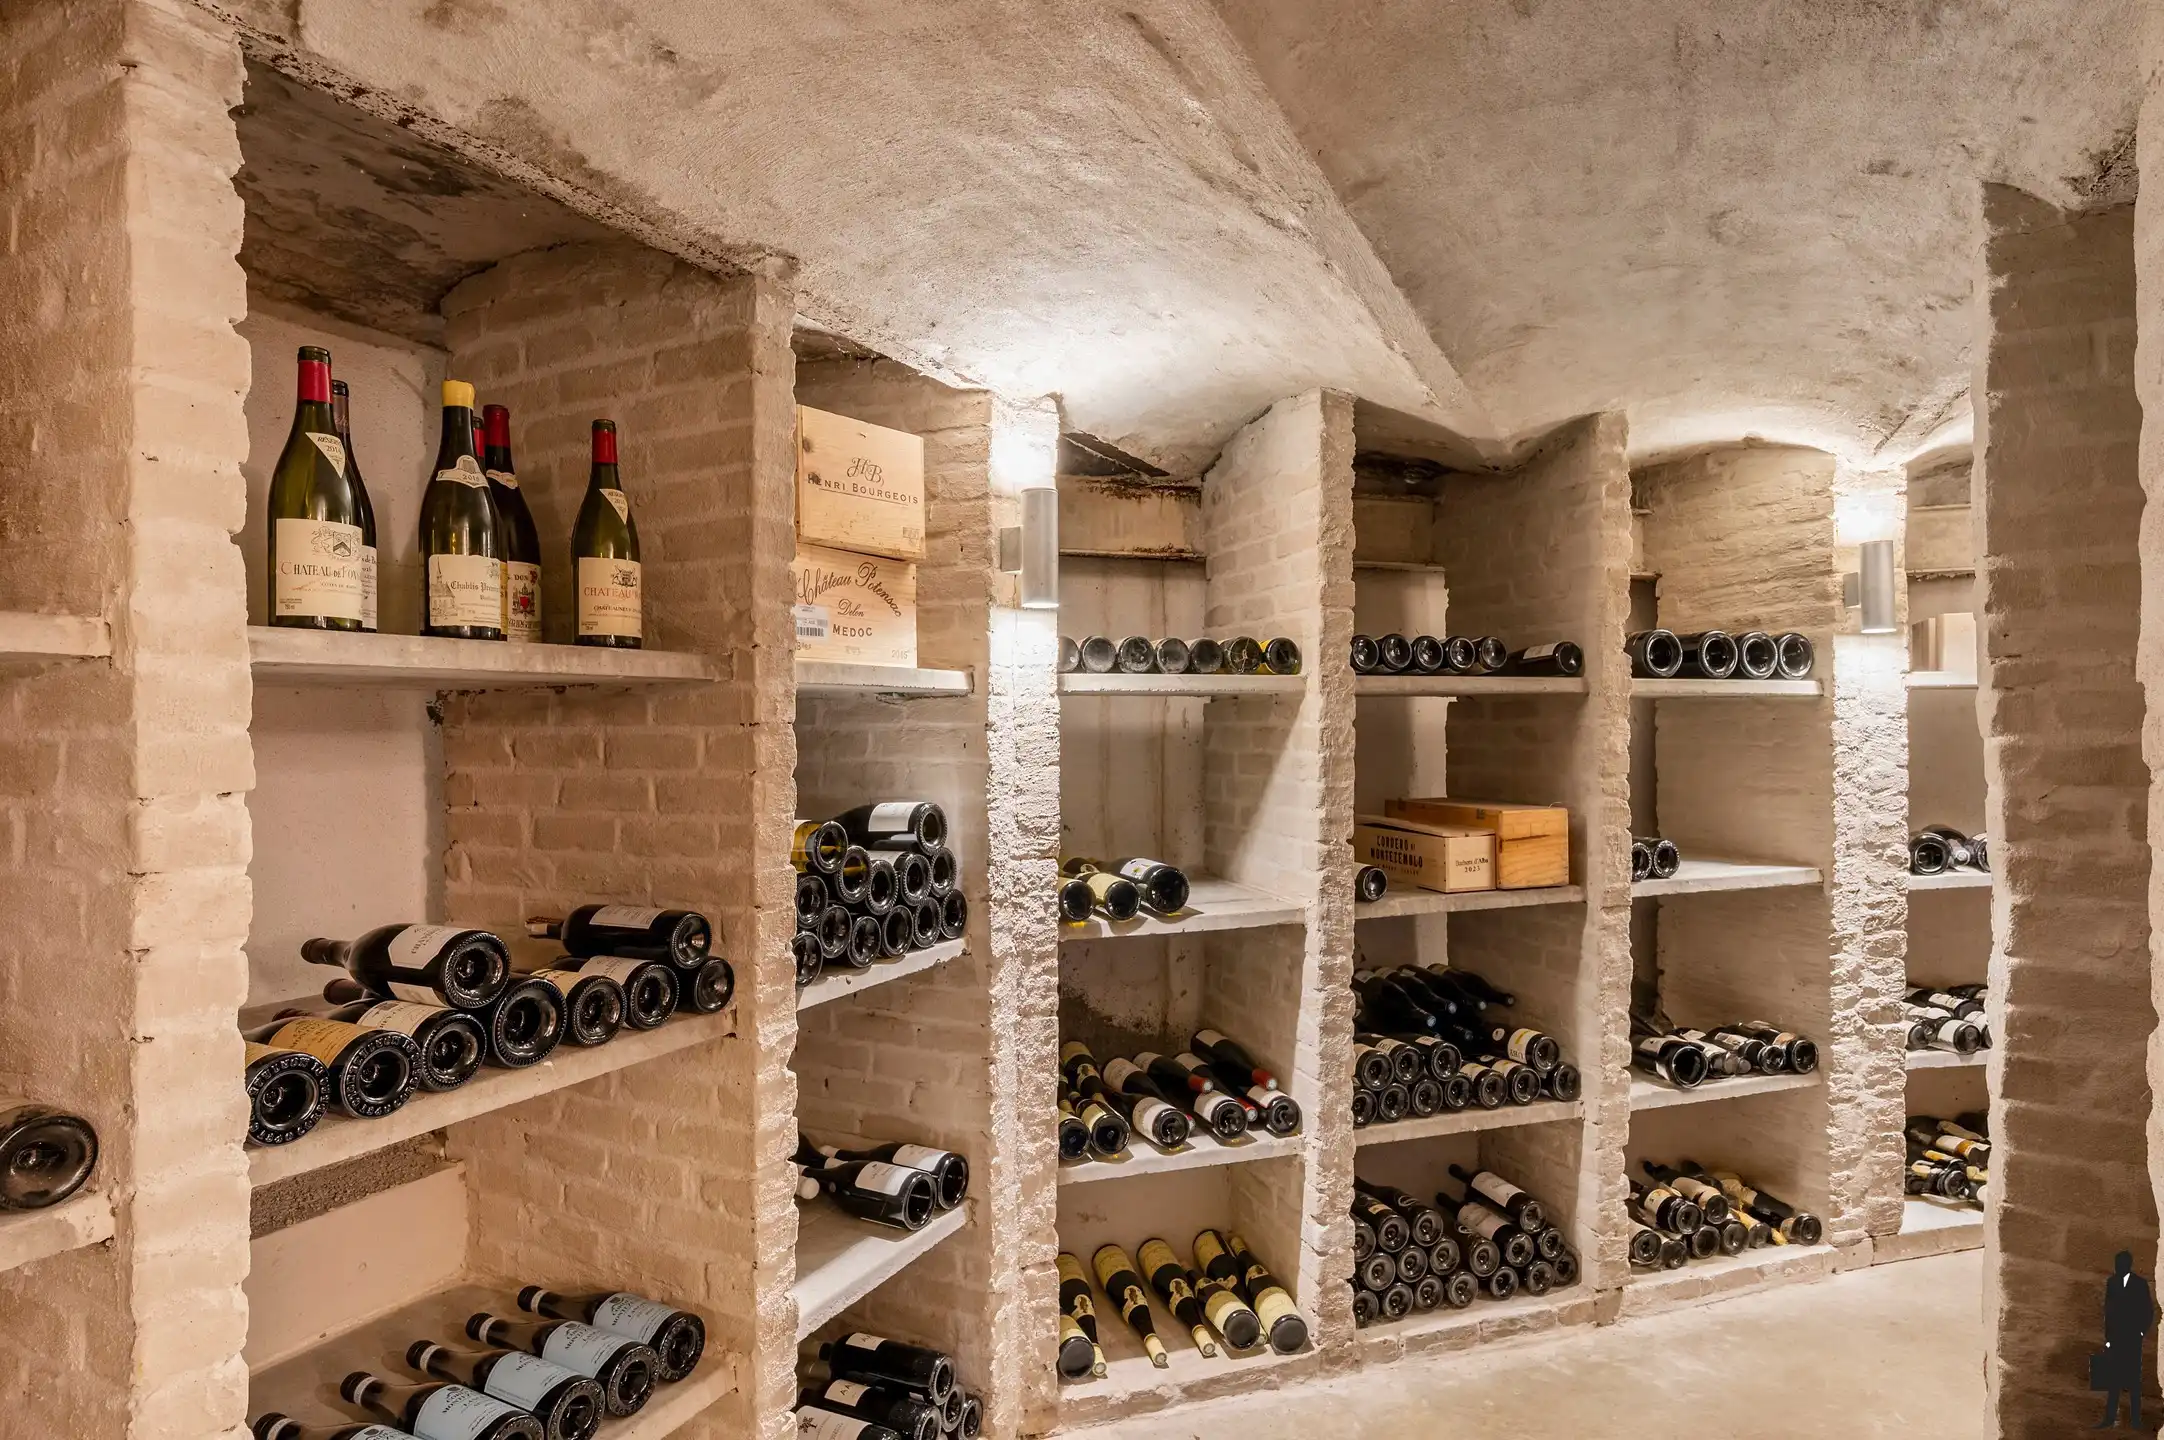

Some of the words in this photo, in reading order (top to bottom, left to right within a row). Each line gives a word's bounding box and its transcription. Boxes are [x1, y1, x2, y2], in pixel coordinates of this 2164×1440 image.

[807, 473, 846, 491] HENRI
[852, 482, 919, 505] BOURGEOIS
[281, 561, 332, 577] CHATEAU
[333, 570, 341, 578] DE
[450, 580, 480, 590] Chablis
[584, 586, 631, 599] CHATEAU
[797, 567, 852, 606] Château
[854, 561, 902, 618] Potensac
[837, 598, 865, 618] Delon
[832, 623, 873, 638] MEDOC
[1376, 835, 1409, 851] CORDERO
[1370, 847, 1423, 868] MONTEZEMOLO
[1464, 865, 1481, 873] 2023
